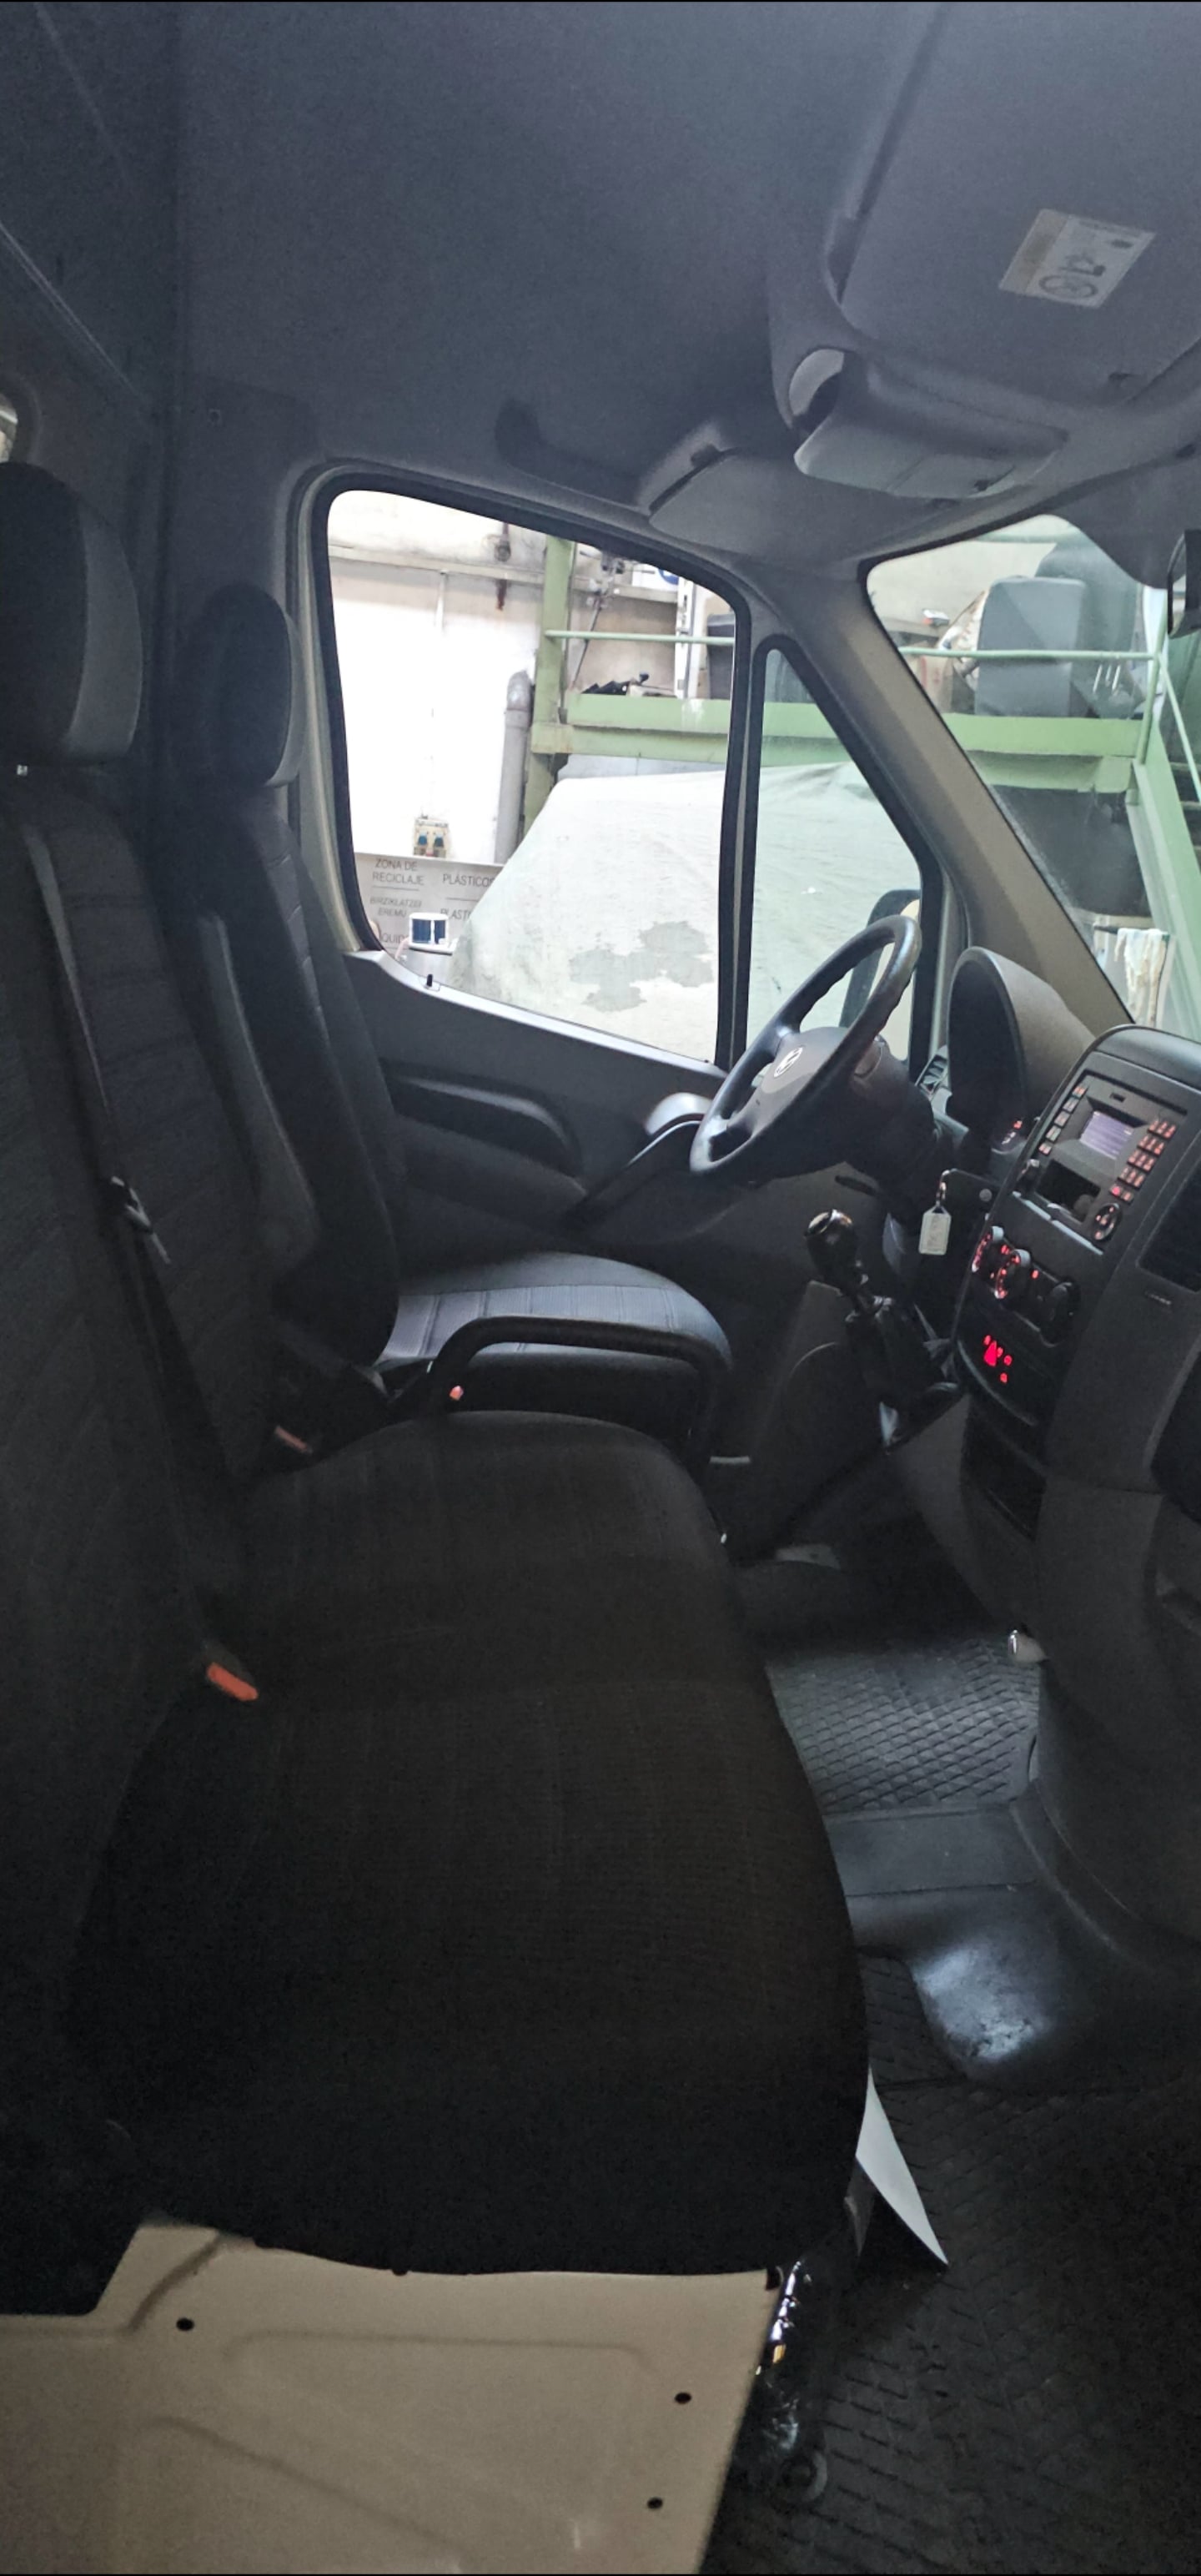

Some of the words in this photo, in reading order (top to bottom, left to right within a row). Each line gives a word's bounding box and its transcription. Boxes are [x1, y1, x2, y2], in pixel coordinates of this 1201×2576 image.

[374, 858, 402, 869] ZONA
[405, 860, 418, 872] DE
[372, 872, 425, 885] RECICLAJE
